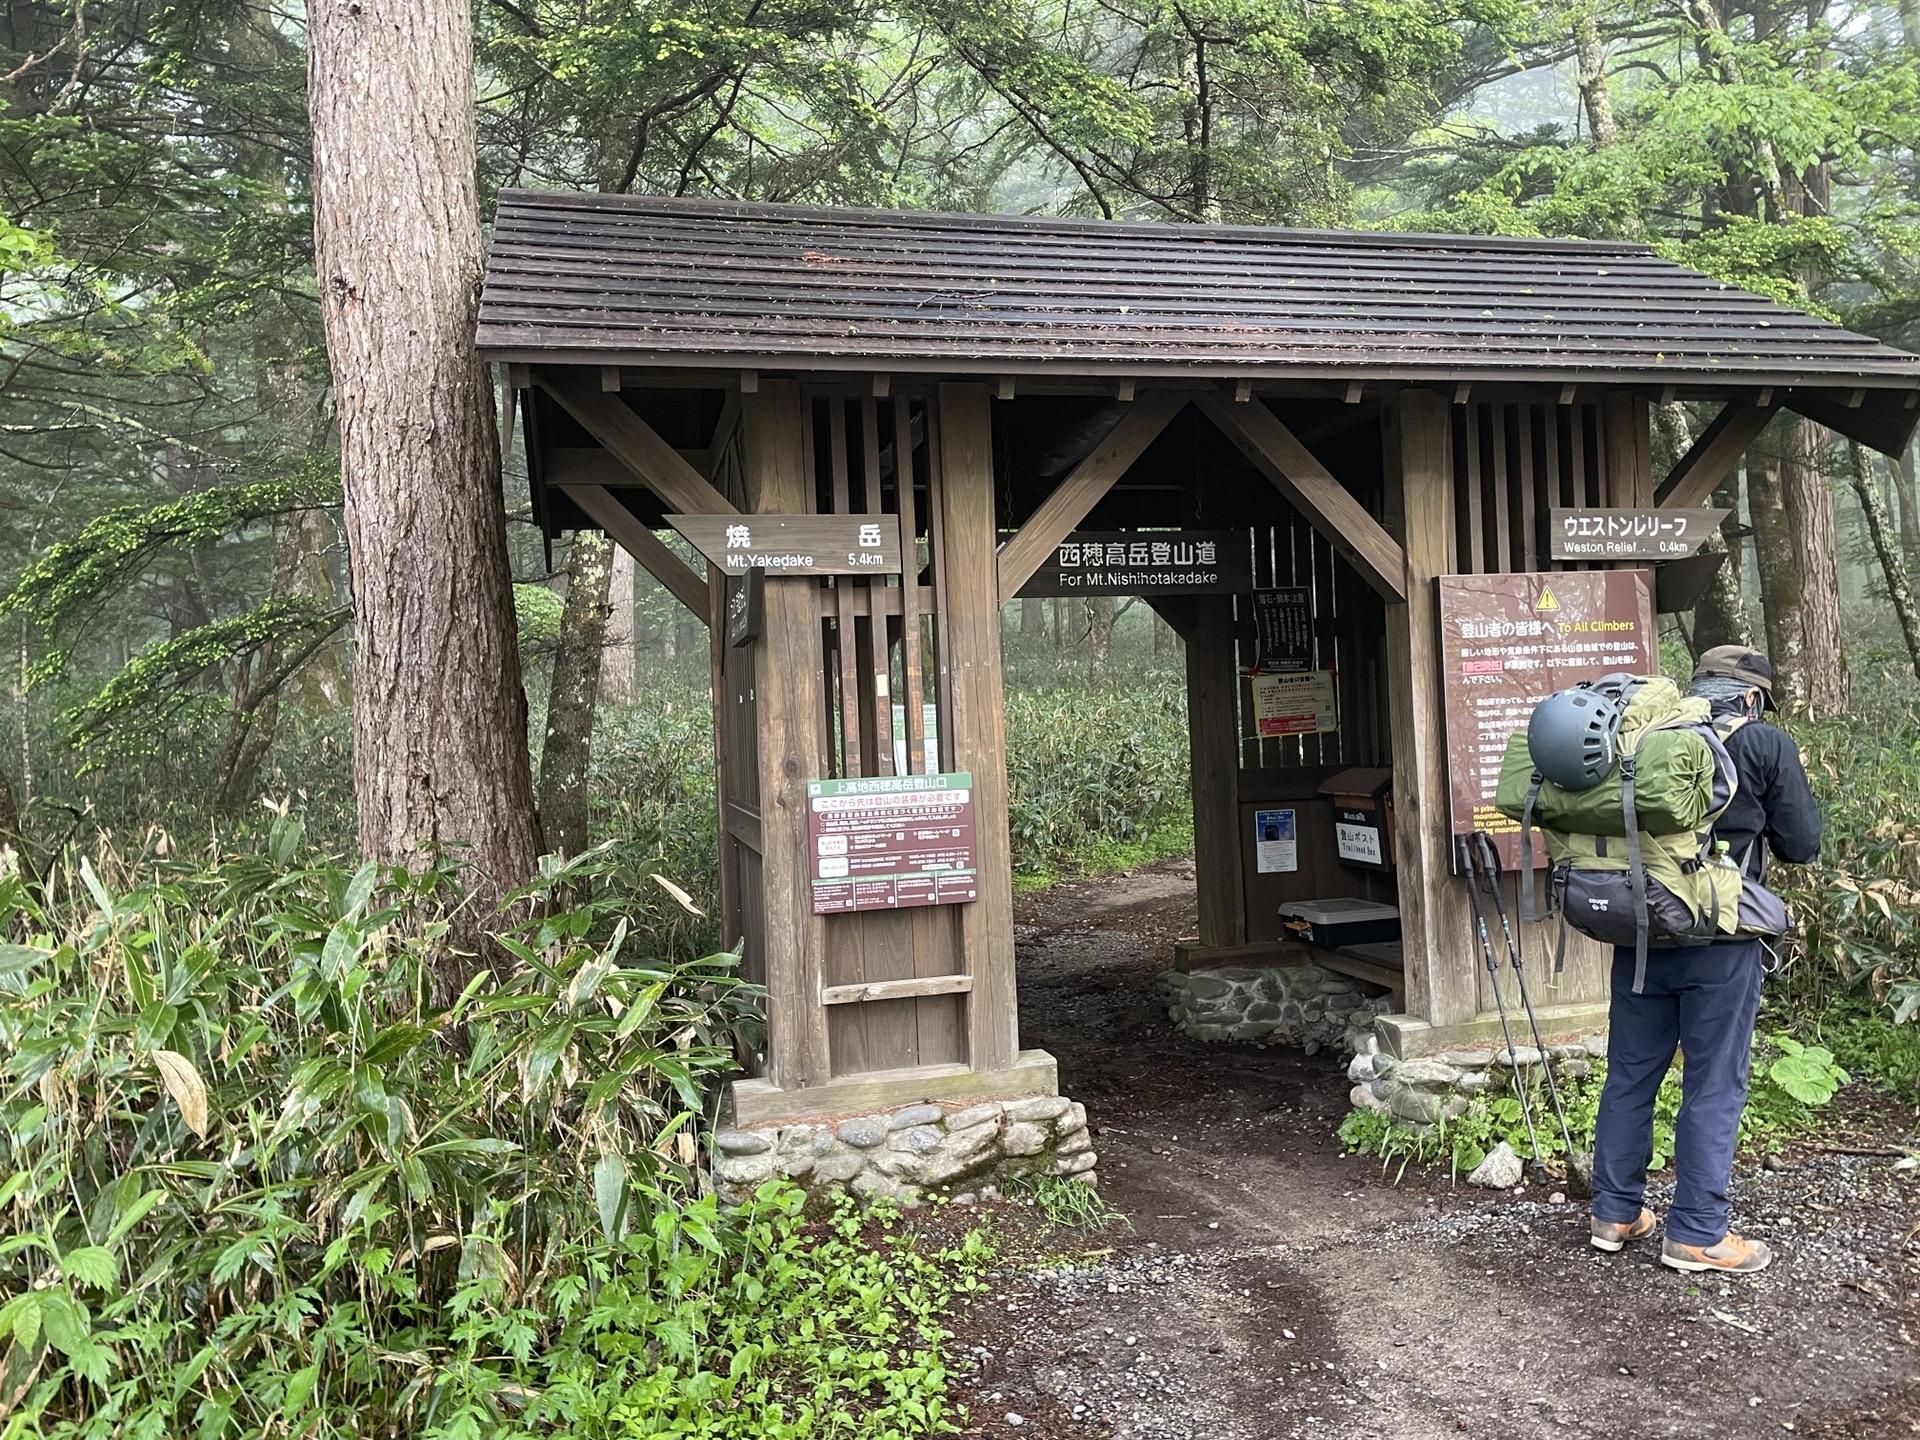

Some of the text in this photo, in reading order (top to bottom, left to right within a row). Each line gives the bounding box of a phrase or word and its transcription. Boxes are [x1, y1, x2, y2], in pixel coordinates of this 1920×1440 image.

[1563, 516, 1687, 538] ウエストンレリーフ
[726, 523, 882, 549] 焼 岳
[1058, 541, 1218, 568] 西穂高岳登山道
[1564, 541, 1688, 553] Weston Relief 0.4km
[726, 552, 883, 568] Mt.Yakedake 5.4km
[1059, 571, 1218, 587] For Mt.Nishihotakadake
[1461, 620, 1555, 639] 登山者の皆様へ
[1558, 620, 1634, 633] To All Climbers
[834, 776, 948, 795] 上高地西穂高岳登山口
[820, 792, 961, 809] ここから先は登山の装備が必要です
[1341, 828, 1375, 844] 登山ポスト
